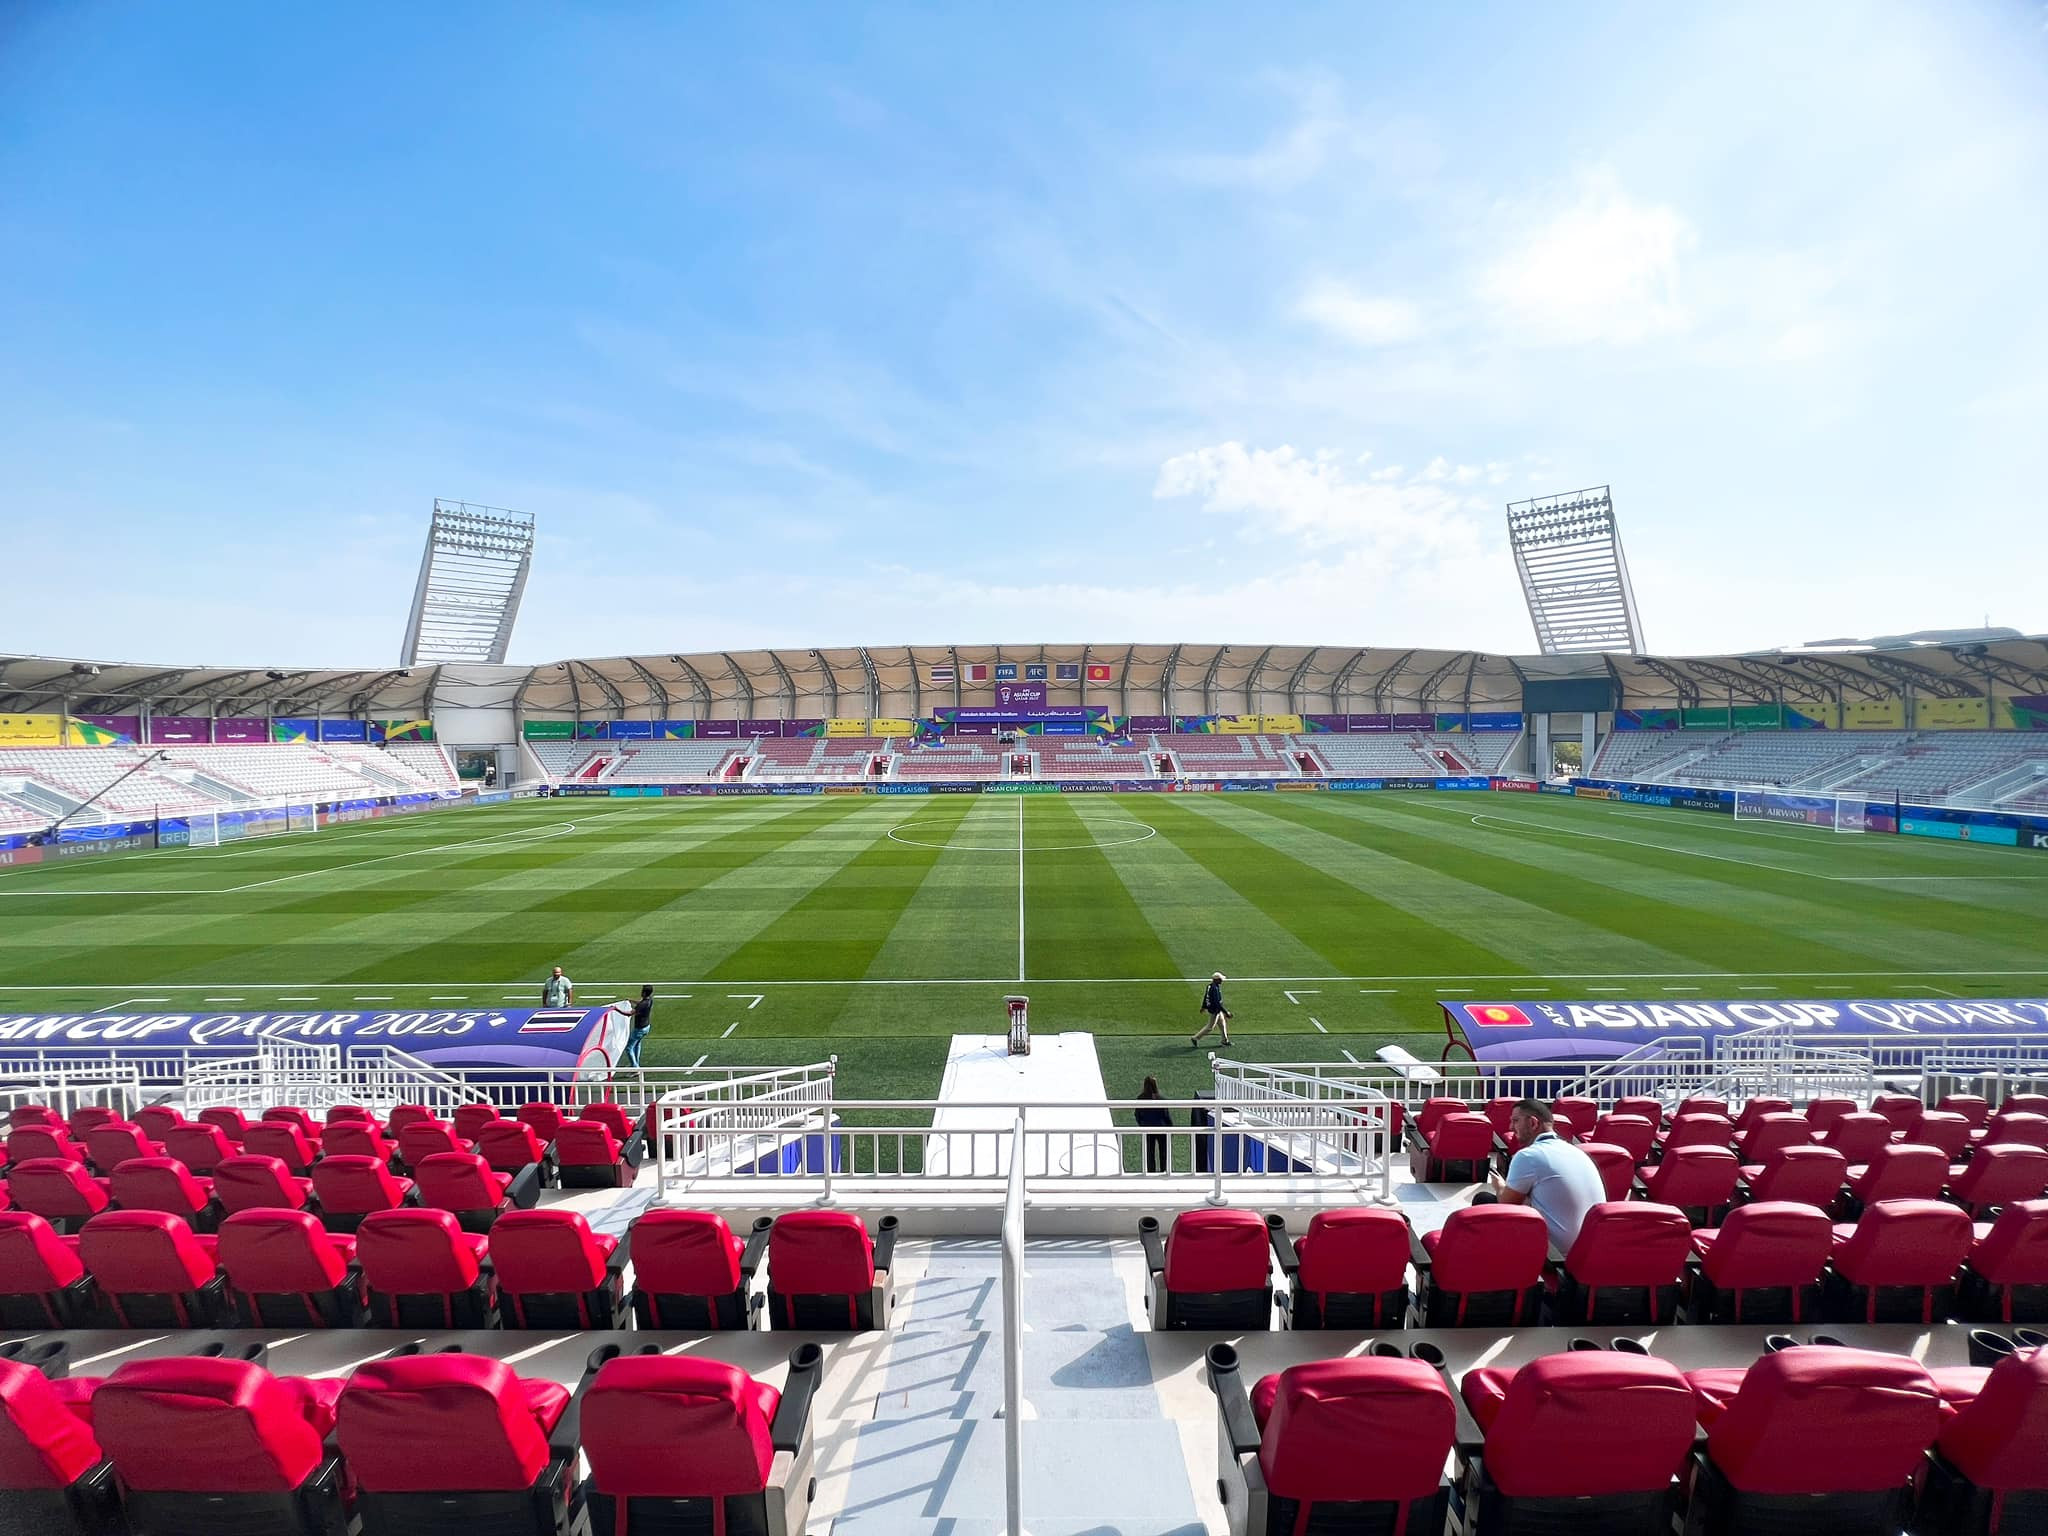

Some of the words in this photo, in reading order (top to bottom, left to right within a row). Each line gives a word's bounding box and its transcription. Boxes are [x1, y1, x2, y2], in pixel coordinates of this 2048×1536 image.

[877, 786, 901, 794] CREDIT
[1620, 792, 1644, 801] CREDIT
[1683, 800, 1720, 809] NEOM.COM
[1767, 808, 1805, 820] AIRWAYS
[59, 844, 95, 856] NEOM
[1535, 1004, 1571, 1027] AFC
[1564, 1004, 1736, 1027] ASIAN
[1726, 1004, 1840, 1027] CUP
[1847, 1003, 2037, 1033] QATAR
[66, 1015, 192, 1039] CUP
[188, 1014, 360, 1045] QATAR
